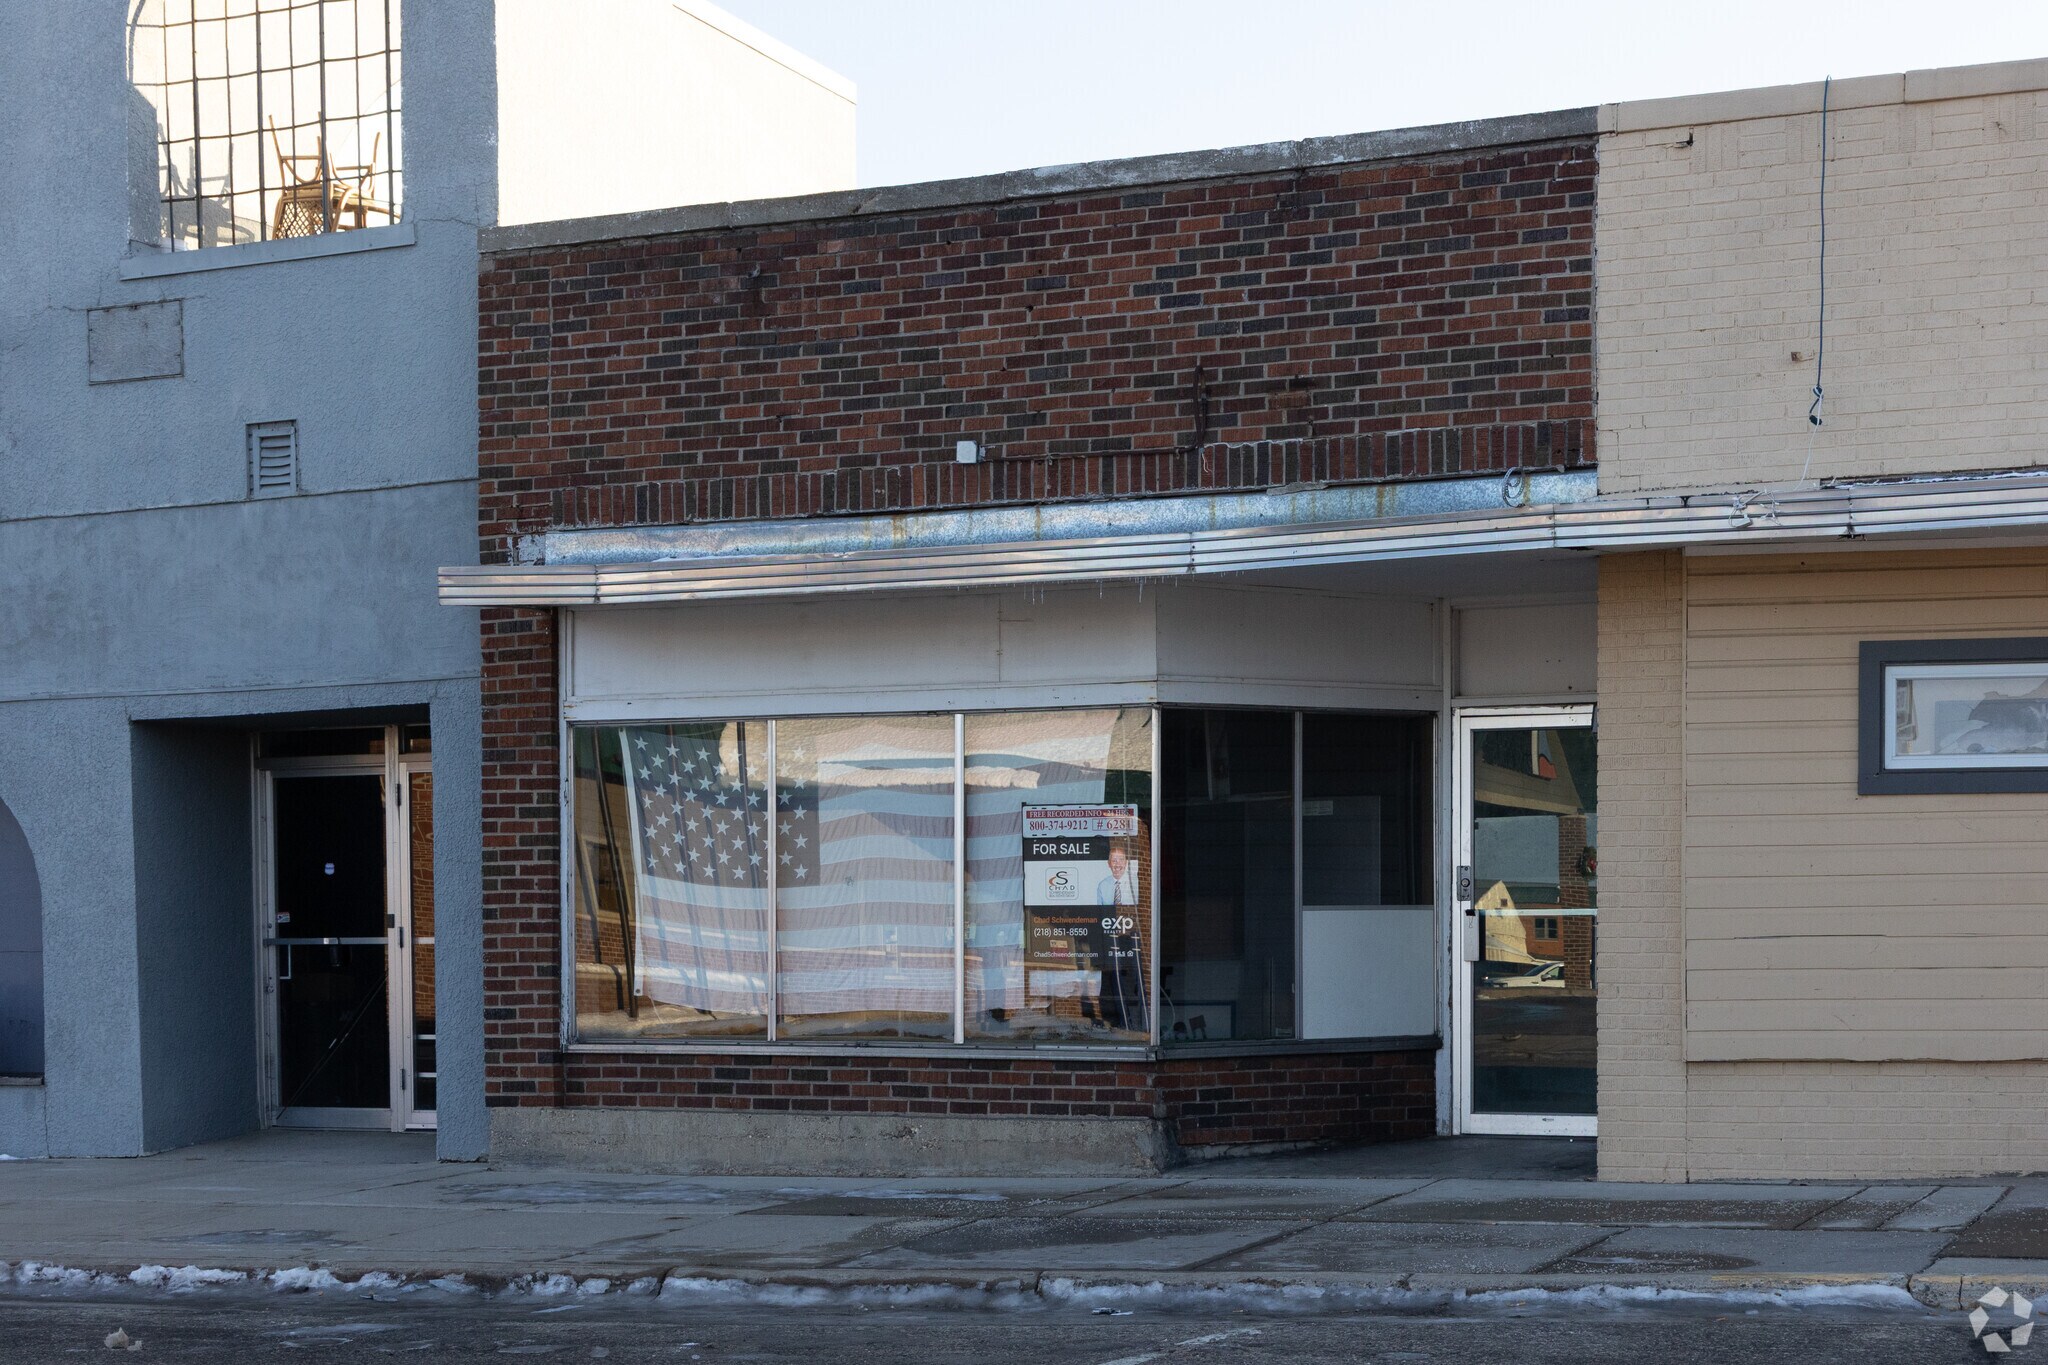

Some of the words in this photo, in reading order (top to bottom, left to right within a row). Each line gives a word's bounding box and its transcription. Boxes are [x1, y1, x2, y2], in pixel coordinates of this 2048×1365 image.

[1030, 810, 1046, 818] FREE
[1047, 809, 1085, 817] RECORDED
[1086, 809, 1102, 817] INFO
[1029, 820, 1088, 831] 800-374-9212
[1033, 843, 1057, 855] FOR
[1060, 843, 1090, 855] SALE
[1033, 916, 1050, 924] Chad
[1051, 916, 1098, 924] Schwendeman
[1033, 927, 1052, 938] (218)
[1053, 927, 1088, 937] 851-8550
